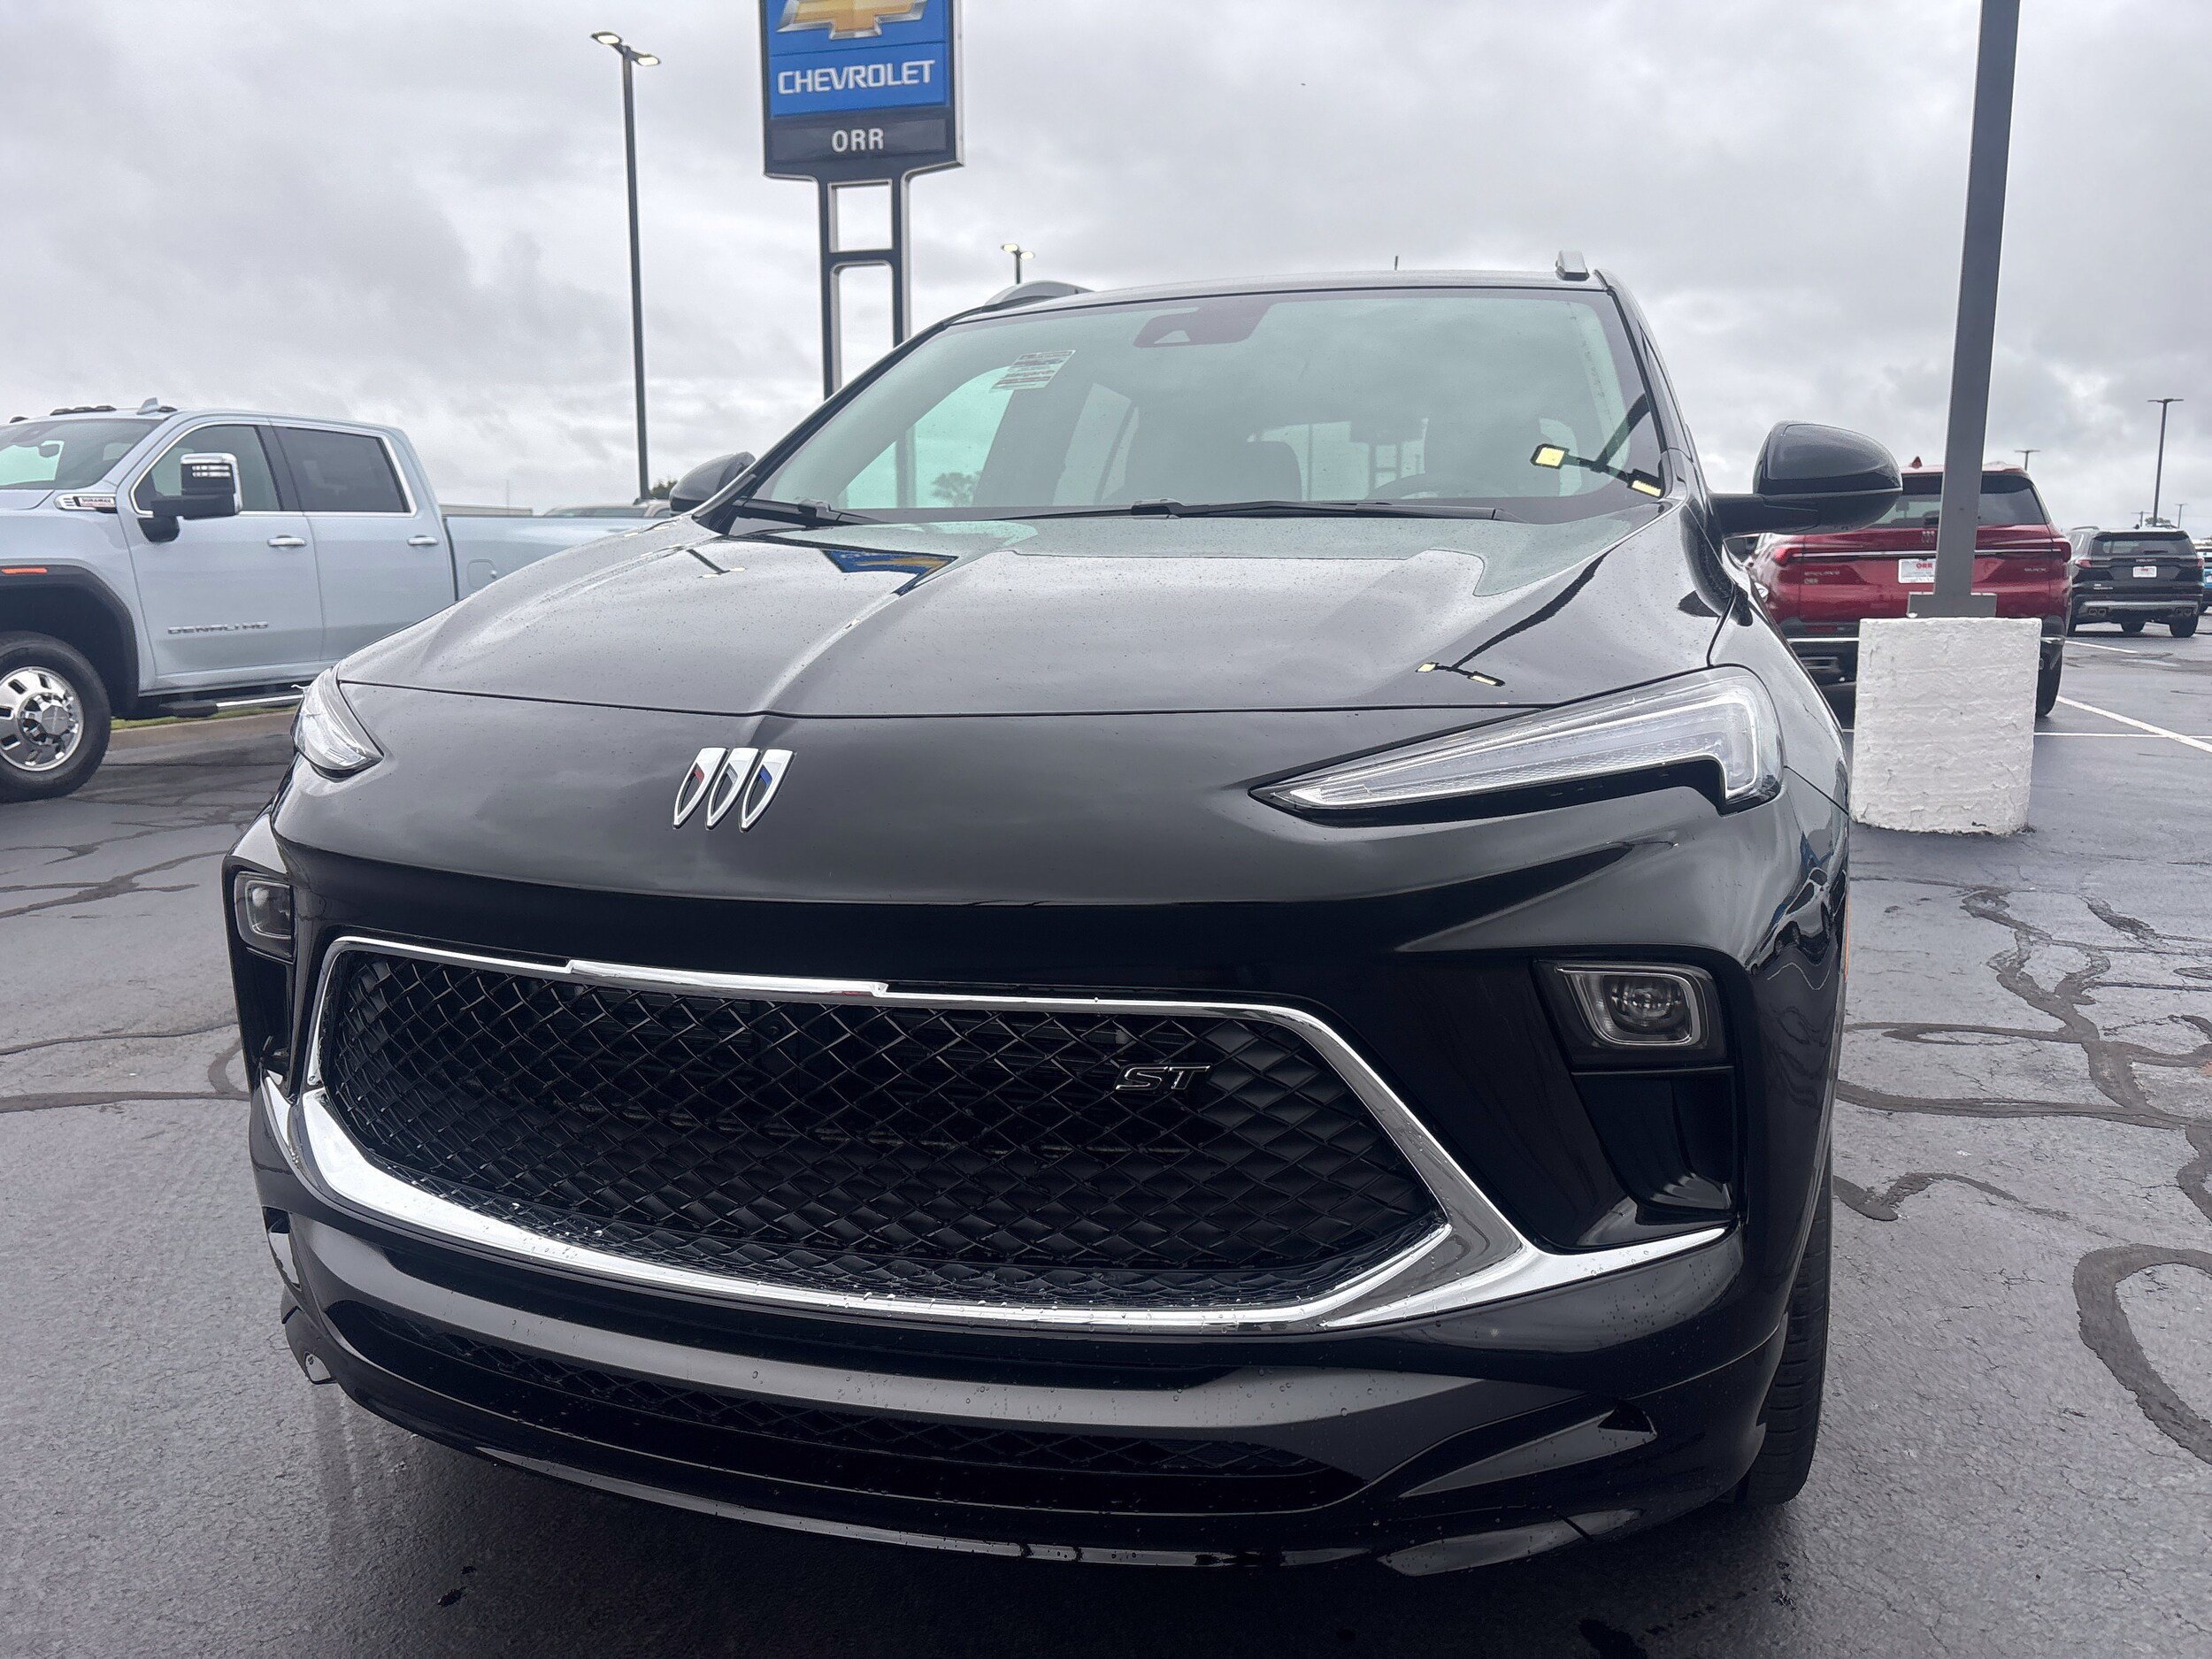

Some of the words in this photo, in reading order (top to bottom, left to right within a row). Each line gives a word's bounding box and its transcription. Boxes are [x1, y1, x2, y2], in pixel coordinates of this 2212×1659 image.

[778, 59, 935, 95] CHEVROLET
[832, 128, 884, 152] ORR
[1115, 1064, 1211, 1091] ST
